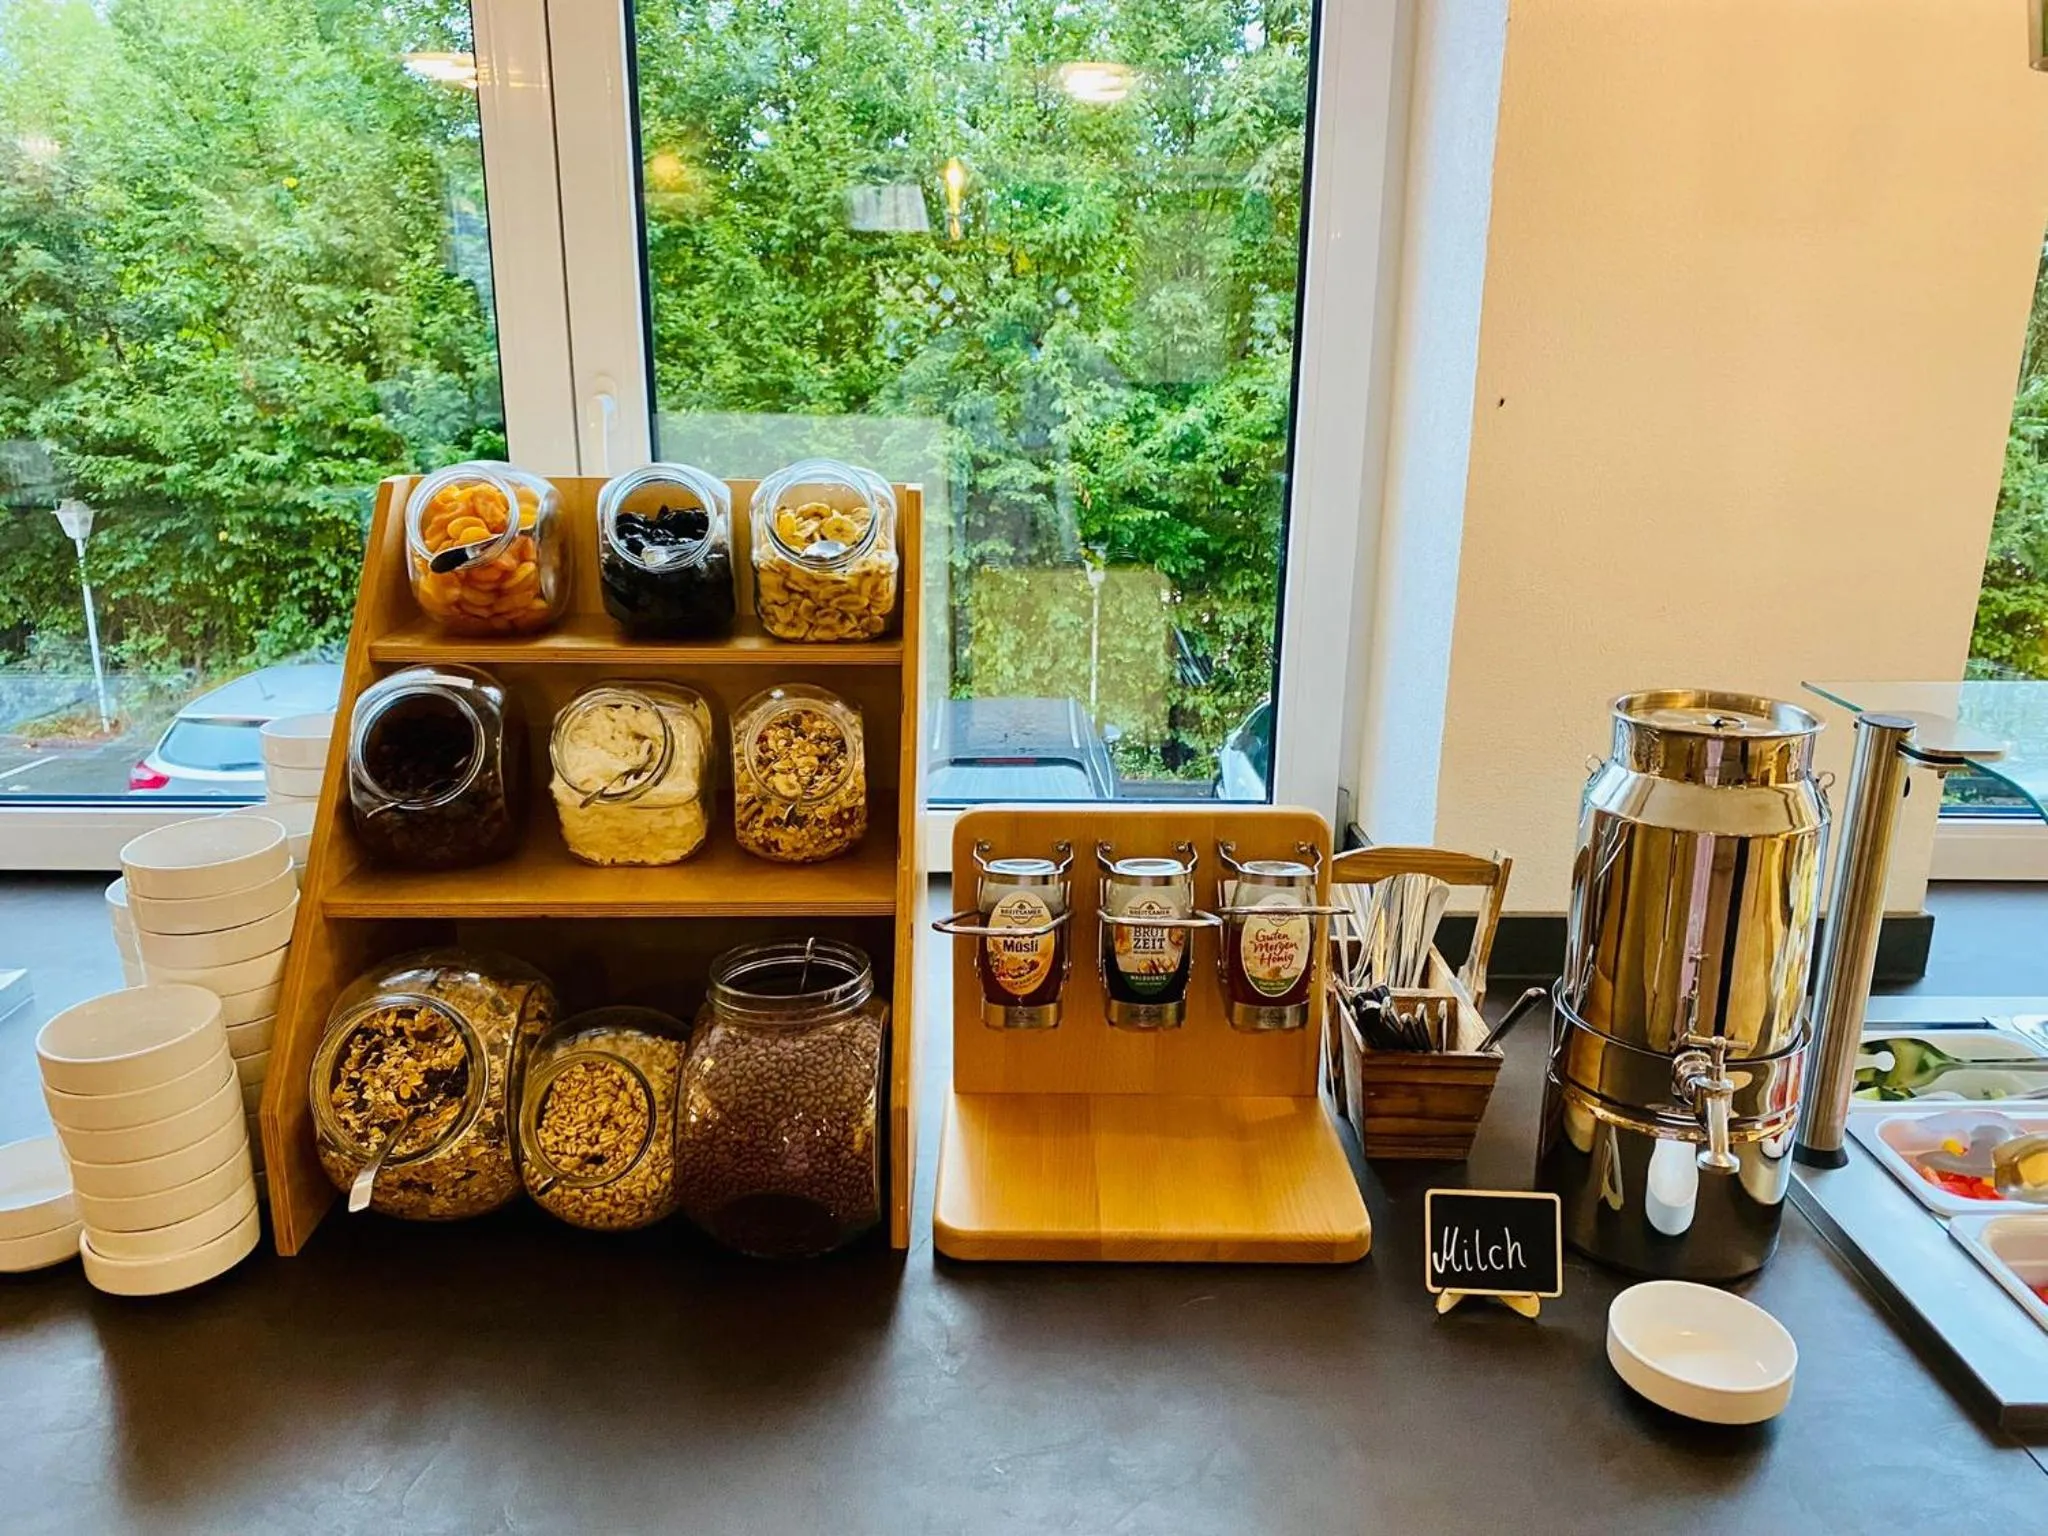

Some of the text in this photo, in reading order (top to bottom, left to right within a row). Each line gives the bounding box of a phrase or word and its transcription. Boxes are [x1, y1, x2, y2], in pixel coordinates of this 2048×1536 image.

[1133, 925, 1164, 938] BROT
[1256, 928, 1290, 942] Guten
[1003, 938, 1038, 953] Müsli
[1133, 937, 1165, 950] ZEIT
[1250, 940, 1299, 955] Morgen
[1260, 952, 1294, 970] Honig
[1432, 1225, 1527, 1274] Milch
